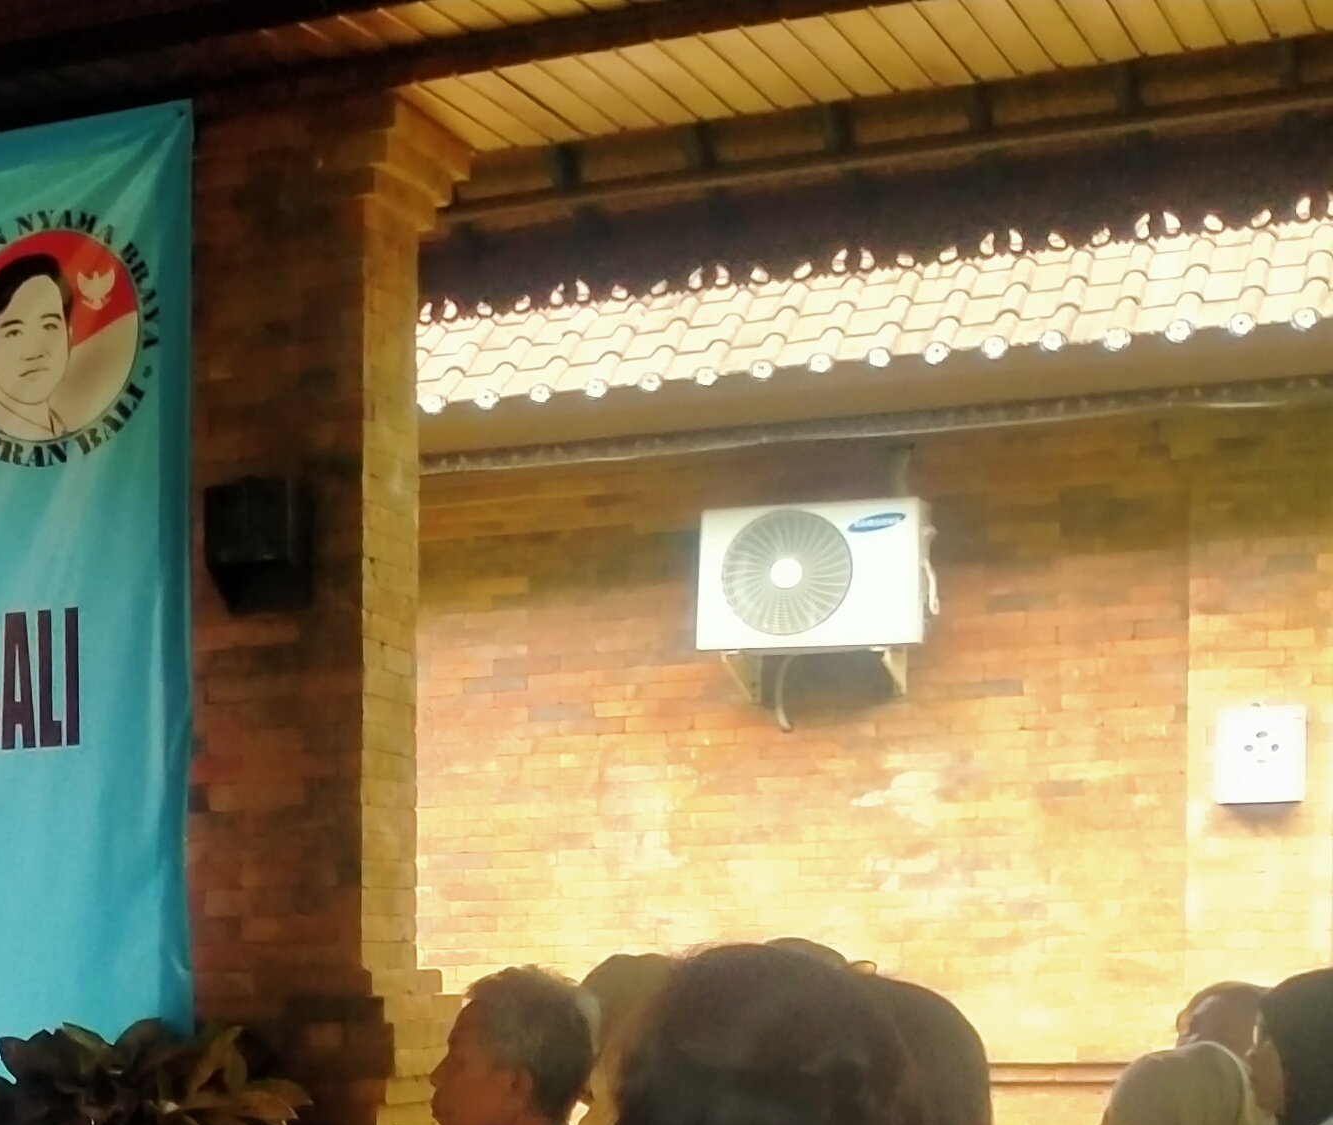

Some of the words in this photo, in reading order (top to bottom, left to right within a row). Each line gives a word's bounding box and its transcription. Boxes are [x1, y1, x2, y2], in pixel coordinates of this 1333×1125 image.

[15, 209, 114, 245] NYAMA
[121, 240, 159, 350] BRAYA
[74, 382, 147, 455] BALI
